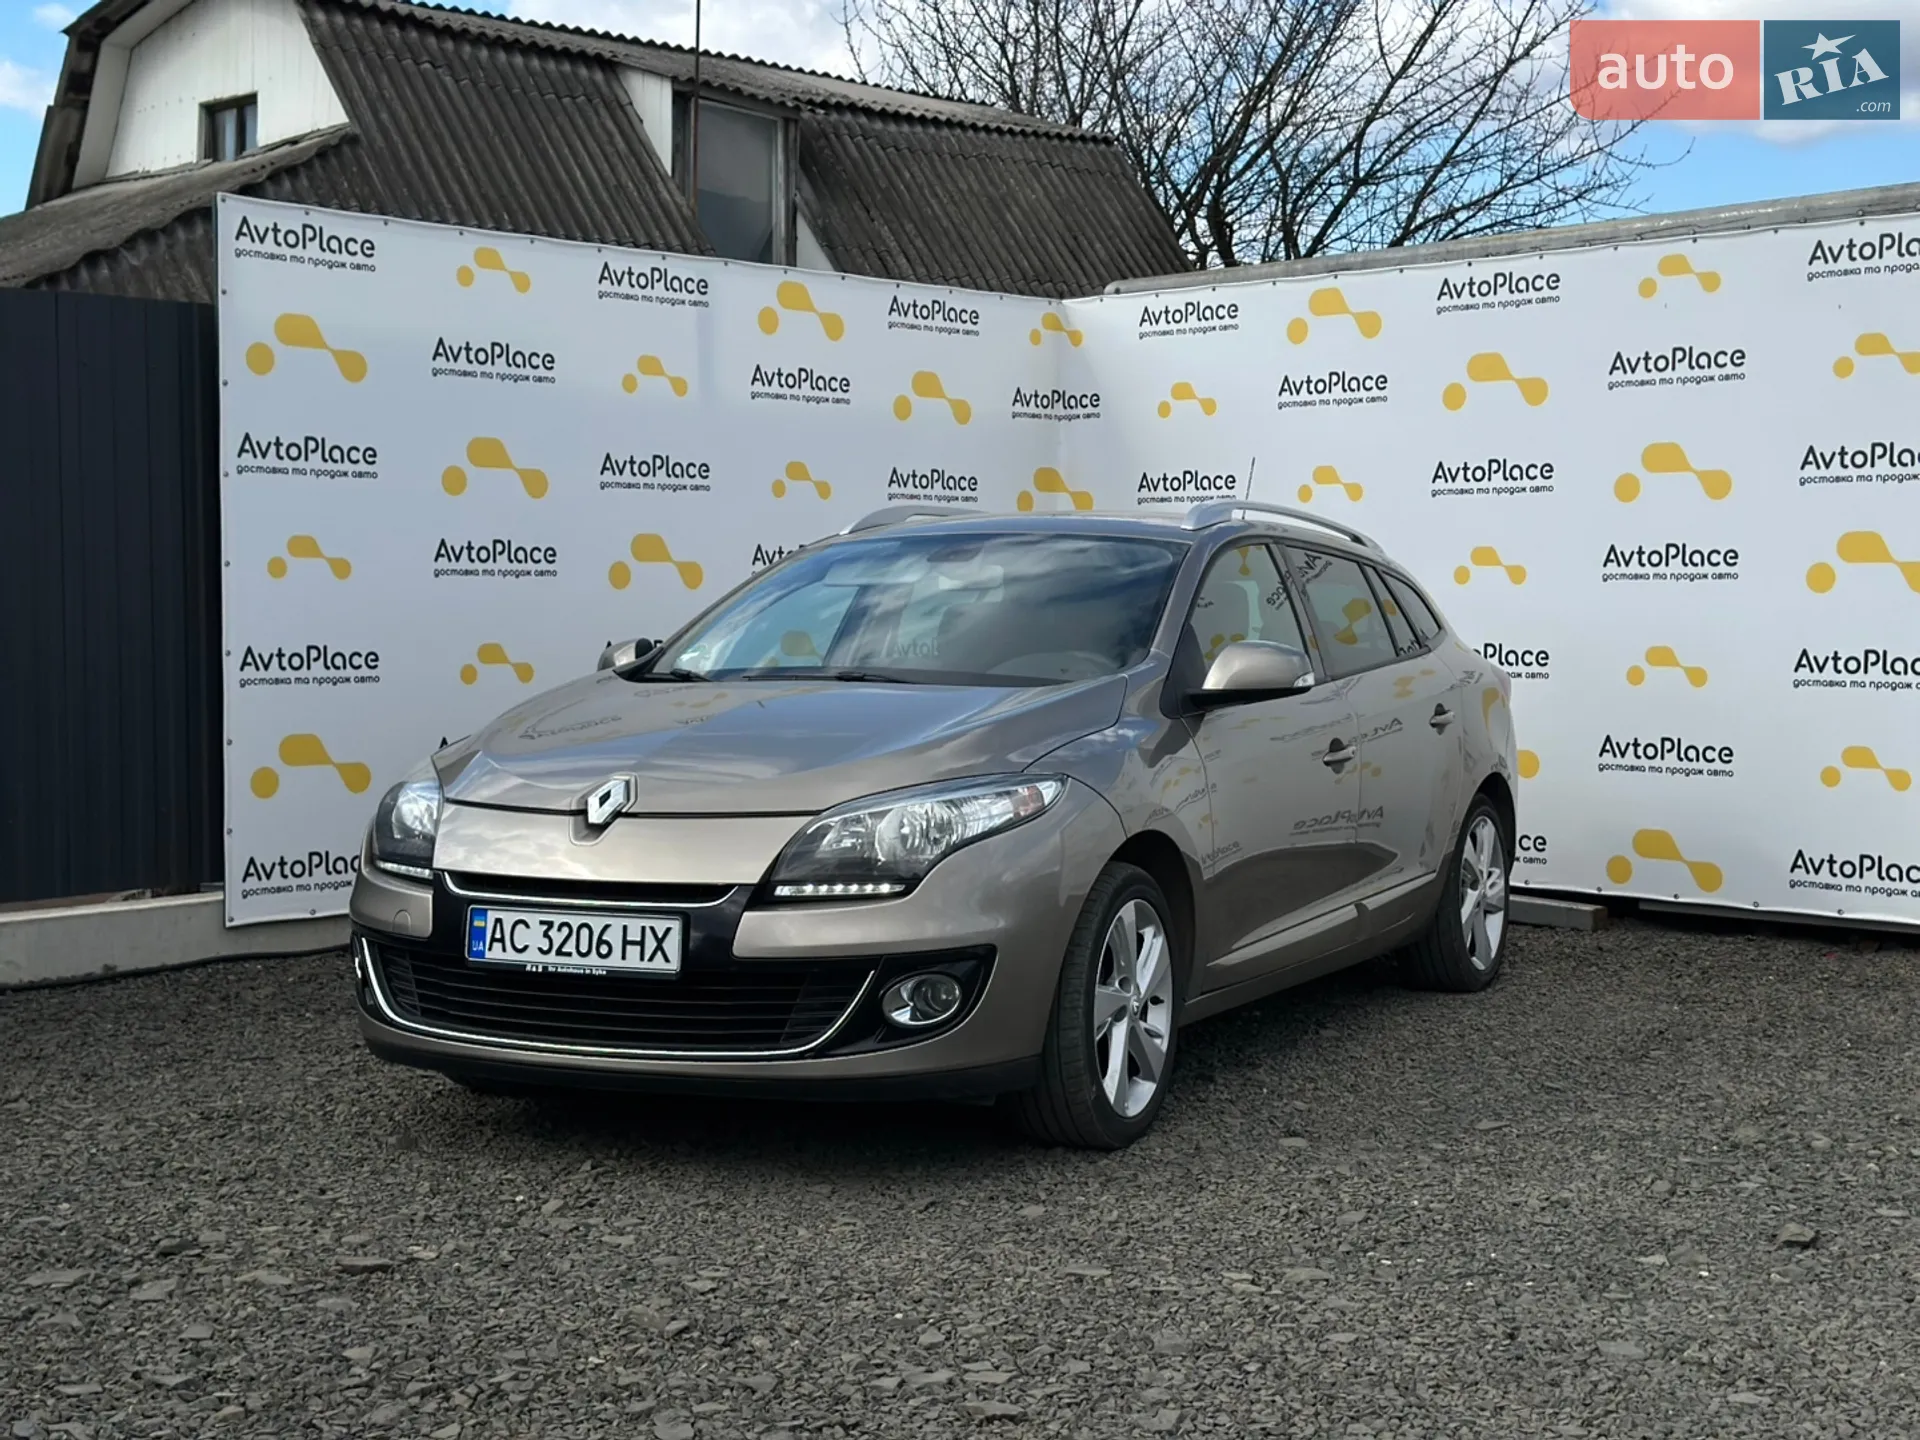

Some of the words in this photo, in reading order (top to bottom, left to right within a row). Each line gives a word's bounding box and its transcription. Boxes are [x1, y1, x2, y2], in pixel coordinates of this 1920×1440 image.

[235, 216, 376, 258] AvtoPlace
[1808, 232, 1920, 266] AvtoPla
[290, 256, 305, 264] та
[350, 263, 376, 272] авто
[1864, 265, 1881, 274] та
[598, 262, 708, 296] AvtoPlace
[1436, 272, 1561, 302] AvtoPlace
[888, 295, 979, 326] AvtoPlace
[1535, 296, 1560, 304] авто
[1139, 301, 1239, 328] AvtoPlace
[432, 337, 555, 370] AvtoPlace
[1608, 346, 1746, 376] AvtoPlace
[480, 371, 494, 379] та
[532, 376, 555, 384] авто
[751, 364, 850, 393] AvtoPlace
[1278, 371, 1388, 398] AvtoPlace
[1718, 373, 1746, 381] авто
[1012, 387, 1100, 410] AvtoPlace
[237, 432, 377, 466] AvtoPlace
[1800, 442, 1920, 470] AvtoPla
[292, 468, 307, 476] та
[351, 471, 378, 479] авто
[600, 452, 710, 480] AvtoPlace
[1432, 458, 1554, 485] AvtoPlace
[1856, 474, 1873, 482] та
[888, 467, 978, 493] AvtoPlace
[1138, 470, 1236, 492] AvtoPlace
[434, 538, 556, 565] AvtoPlace
[1603, 543, 1739, 568] AvtoPlace
[240, 645, 379, 674] AvtoPlace
[1473, 643, 1549, 667] Place
[1794, 648, 1920, 676] AvtoPlac
[294, 677, 310, 685] та
[1850, 680, 1866, 688] та
[1599, 734, 1734, 765] AvtoPlace
[1706, 769, 1734, 778] авто
[242, 851, 360, 883] AvtoPlac
[1789, 849, 1920, 884] AvtoPlac
[296, 883, 311, 892] та
[1845, 884, 1862, 892] та
[472, 940, 484, 951] UA
[488, 917, 531, 953] AC
[537, 920, 613, 959] 3206
[621, 924, 673, 963] HX
